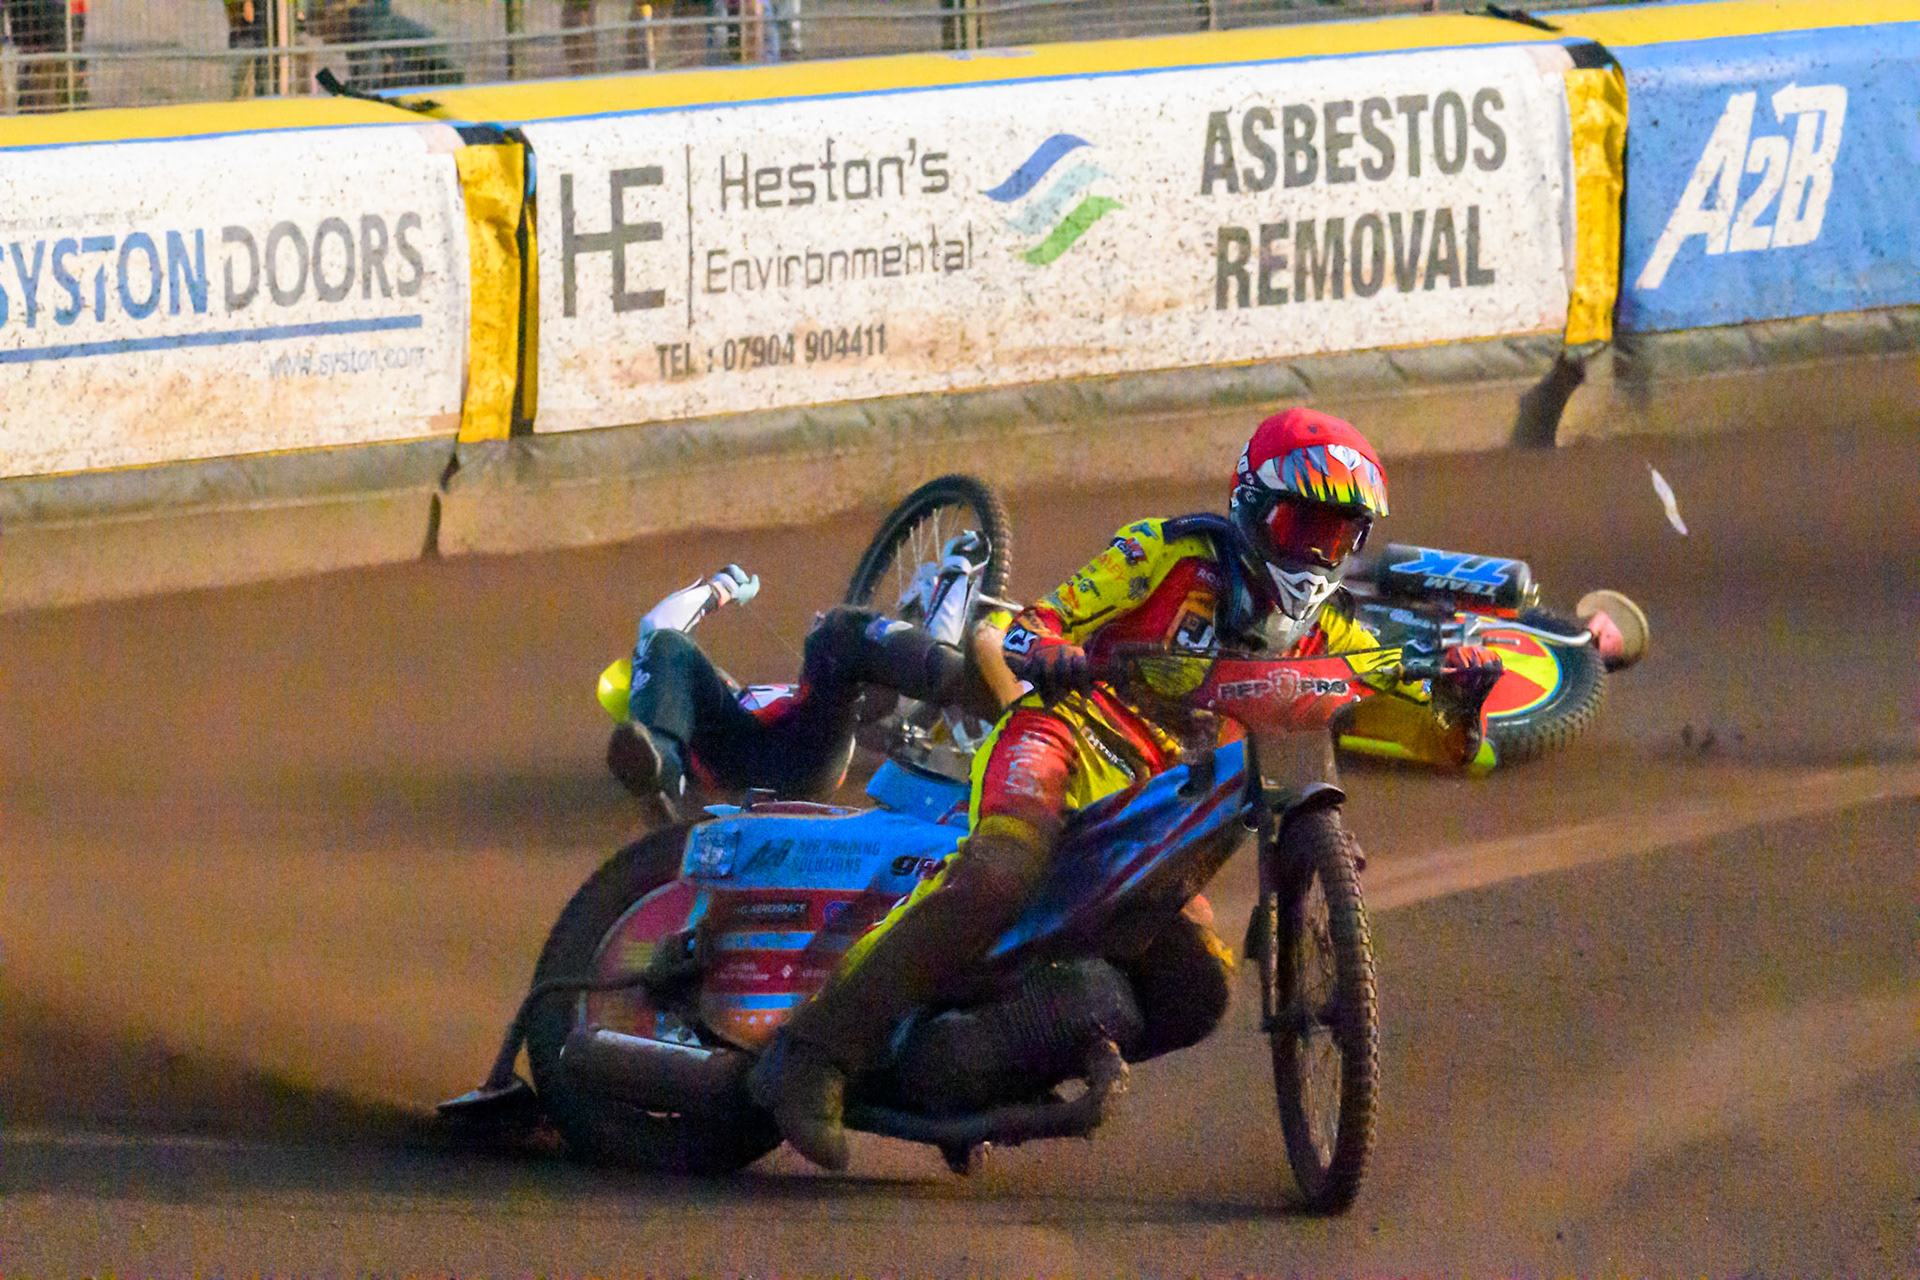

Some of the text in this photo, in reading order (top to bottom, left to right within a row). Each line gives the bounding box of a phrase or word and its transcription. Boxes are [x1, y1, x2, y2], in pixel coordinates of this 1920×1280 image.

[720, 137, 950, 211] Heston's
[1201, 87, 1507, 196] ASBESTOS
[1636, 82, 1848, 290] A2B
[221, 210, 425, 313] DOORS
[706, 219, 974, 295] Environmental
[1215, 204, 1496, 311] REMOVAL
[723, 332, 796, 372] 07904
[804, 323, 887, 363] 904411
[1423, 576, 1498, 598] TEAM
